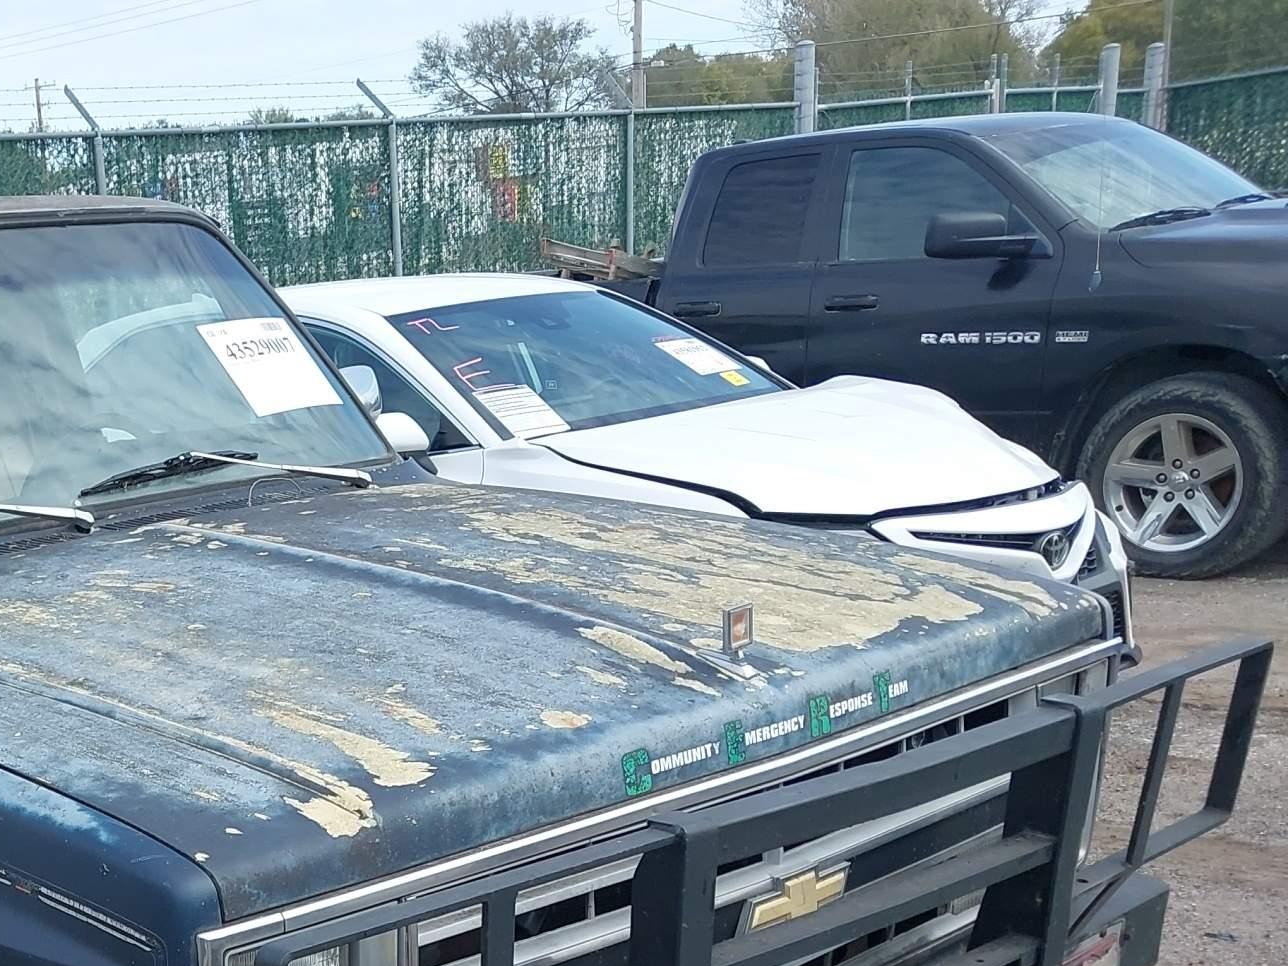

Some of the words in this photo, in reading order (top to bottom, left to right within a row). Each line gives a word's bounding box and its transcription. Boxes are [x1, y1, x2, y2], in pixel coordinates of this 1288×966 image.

[226, 337, 296, 361] 43529007
[920, 332, 980, 345] RAM
[985, 331, 1041, 344] 1500
[621, 741, 721, 796] COMMUNITY
[723, 714, 806, 764] EMERGENCY
[808, 692, 872, 737] RESPONSE
[872, 670, 909, 712] TEAM
